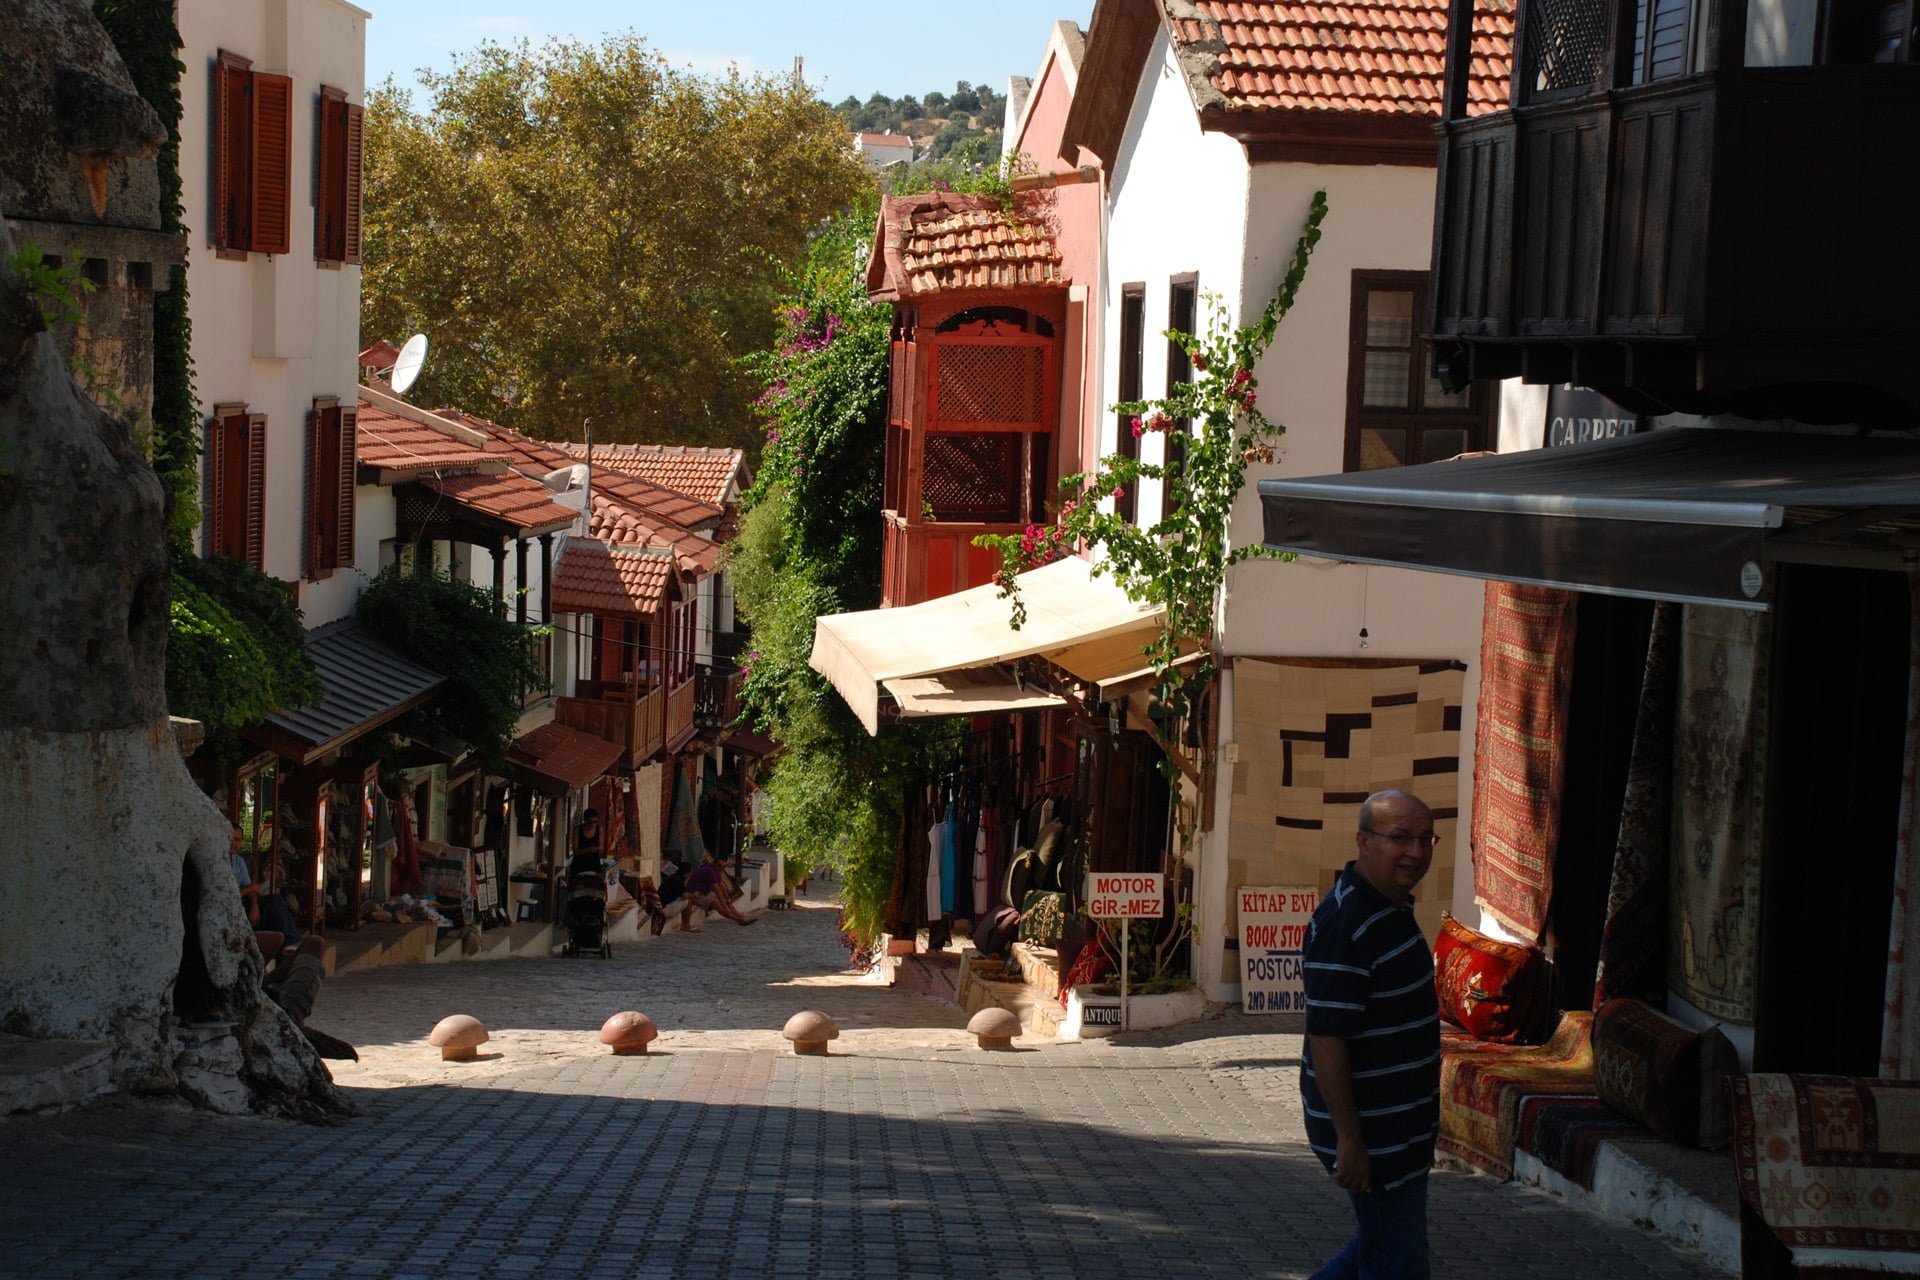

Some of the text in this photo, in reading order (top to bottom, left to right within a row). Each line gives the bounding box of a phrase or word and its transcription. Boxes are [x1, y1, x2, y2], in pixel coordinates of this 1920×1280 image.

[1097, 878, 1155, 894] MOTOR
[1242, 891, 1287, 913] KİTAP
[1246, 925, 1277, 949] BOOK
[1247, 958, 1305, 981] POSTCA
[1248, 990, 1305, 1011] 2ND HAND BO
